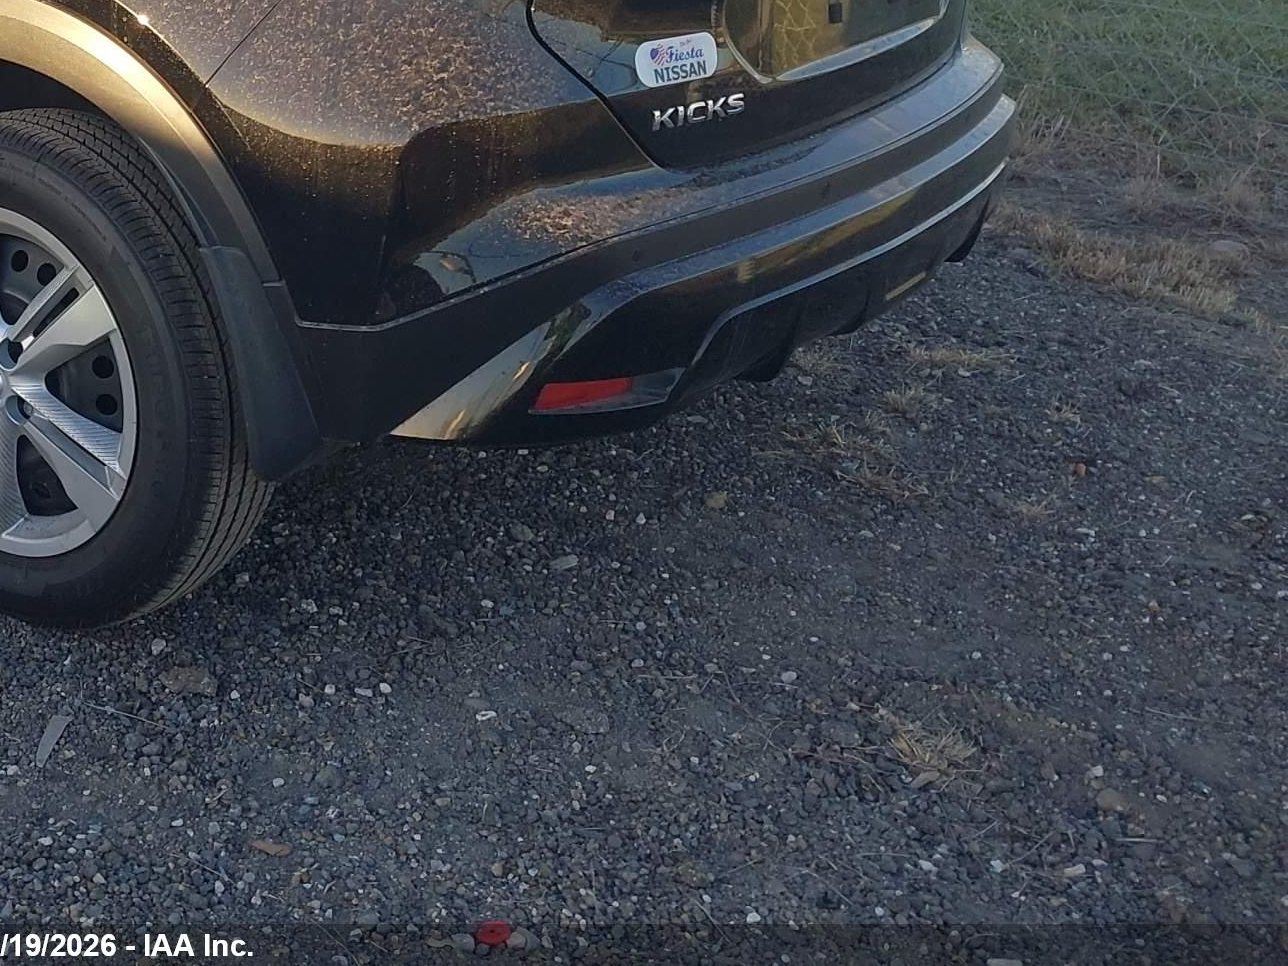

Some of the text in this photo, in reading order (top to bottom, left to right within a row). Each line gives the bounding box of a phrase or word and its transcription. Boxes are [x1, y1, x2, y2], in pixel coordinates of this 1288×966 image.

[665, 45, 705, 64] Fiesta
[654, 60, 708, 84] NISSAN
[652, 93, 745, 132] KICKS
